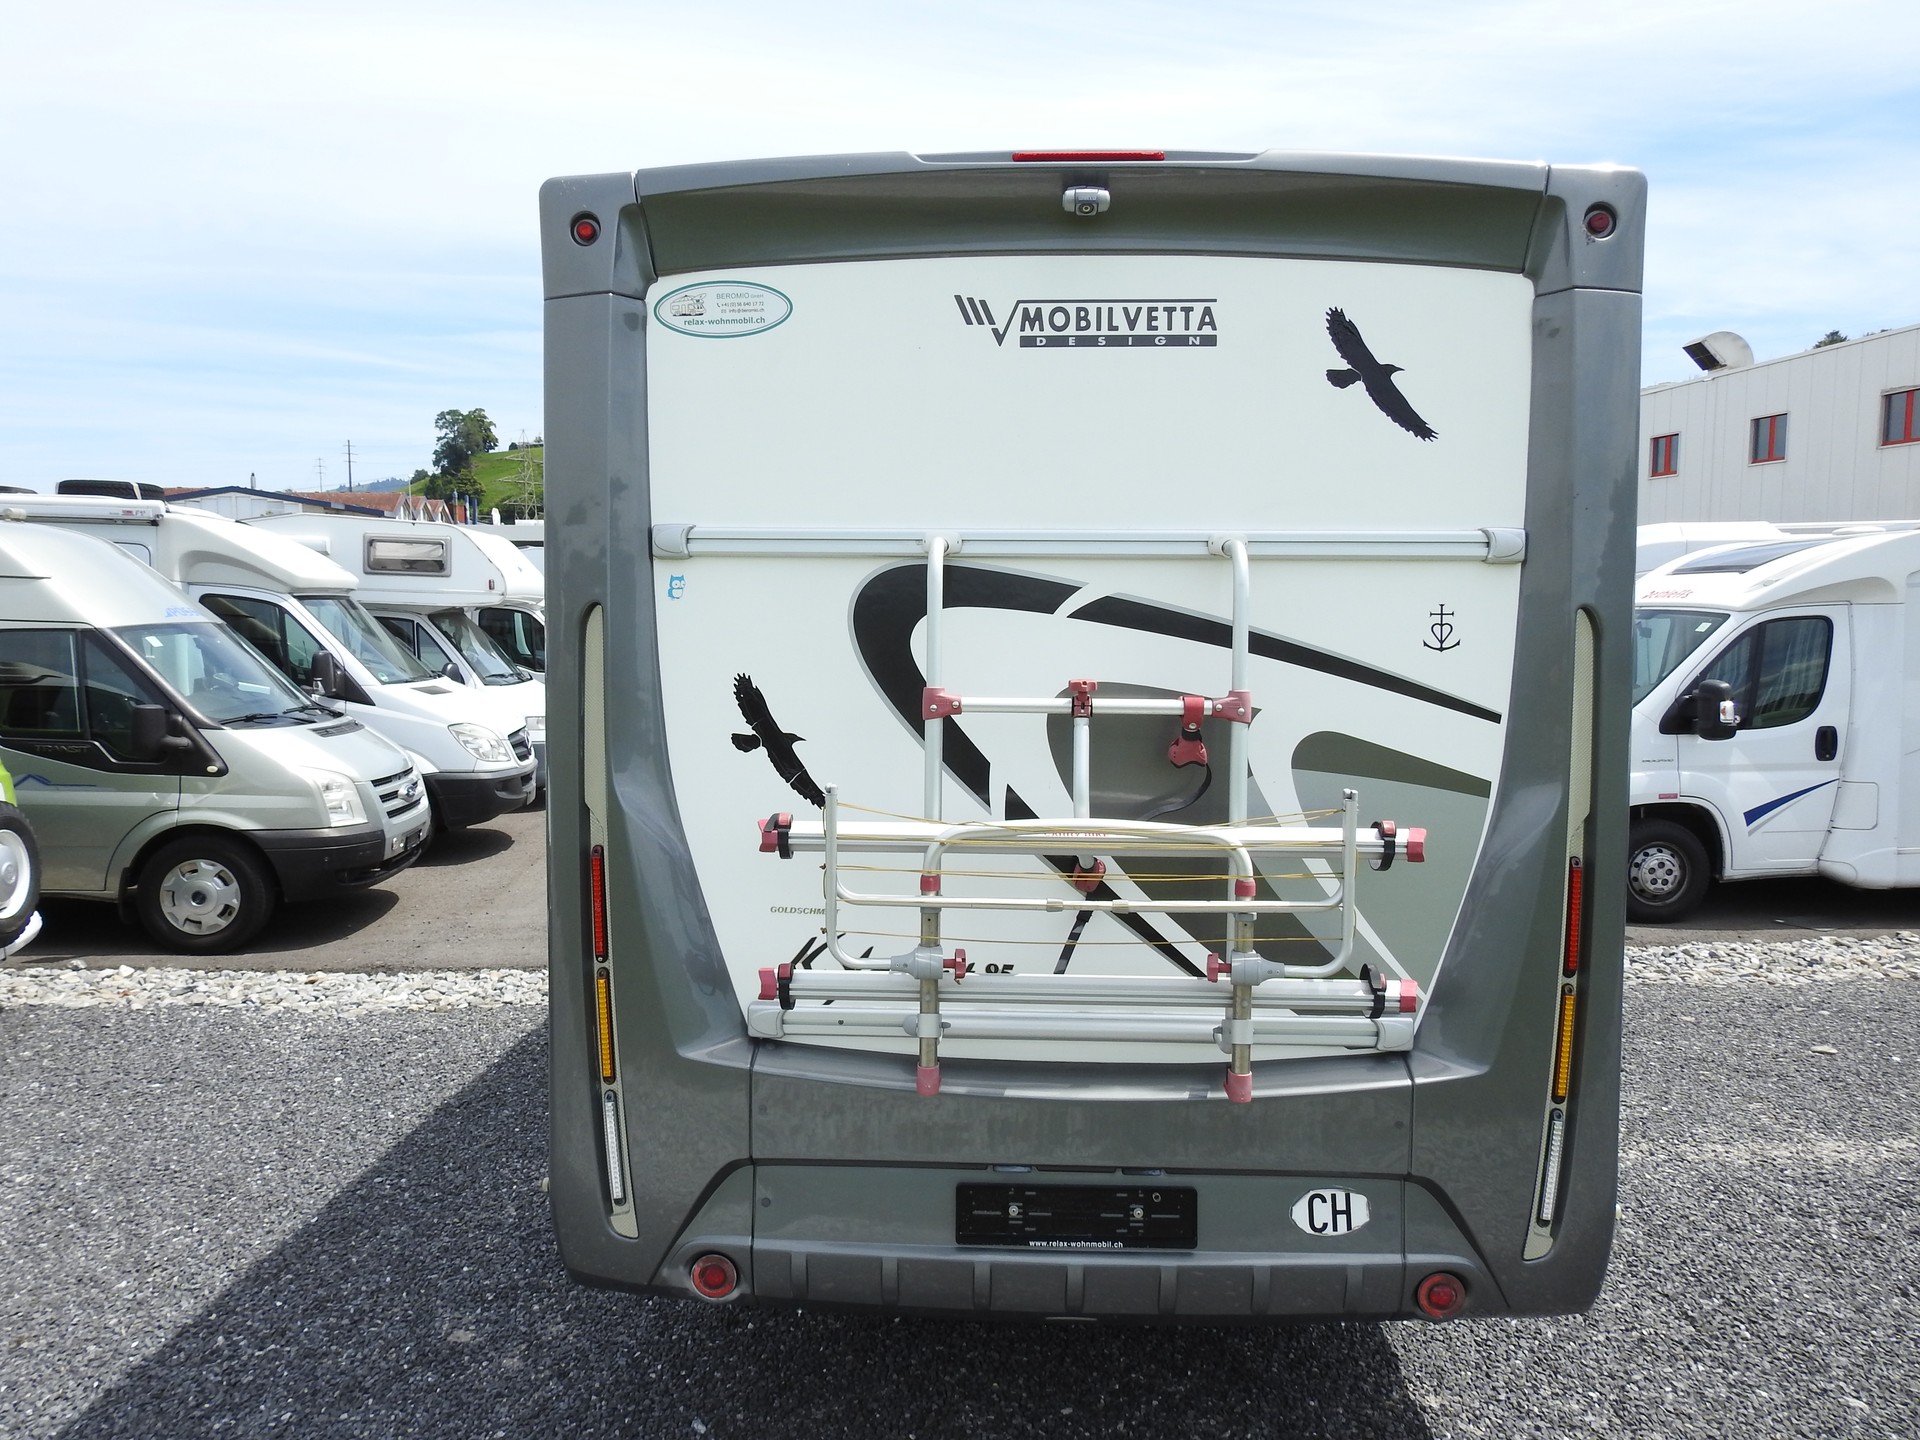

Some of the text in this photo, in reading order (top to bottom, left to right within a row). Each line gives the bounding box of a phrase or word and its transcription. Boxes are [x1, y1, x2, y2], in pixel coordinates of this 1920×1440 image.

[716, 292, 750, 300] BEROMIO
[684, 316, 765, 325] relax-wohnmobil.ch
[1019, 306, 1218, 332] MOBILVETTA
[1036, 336, 1201, 346] DESIGN
[1307, 1193, 1352, 1233] CH
[1029, 1239, 1124, 1249] www.relax-wohnmobil.ch
